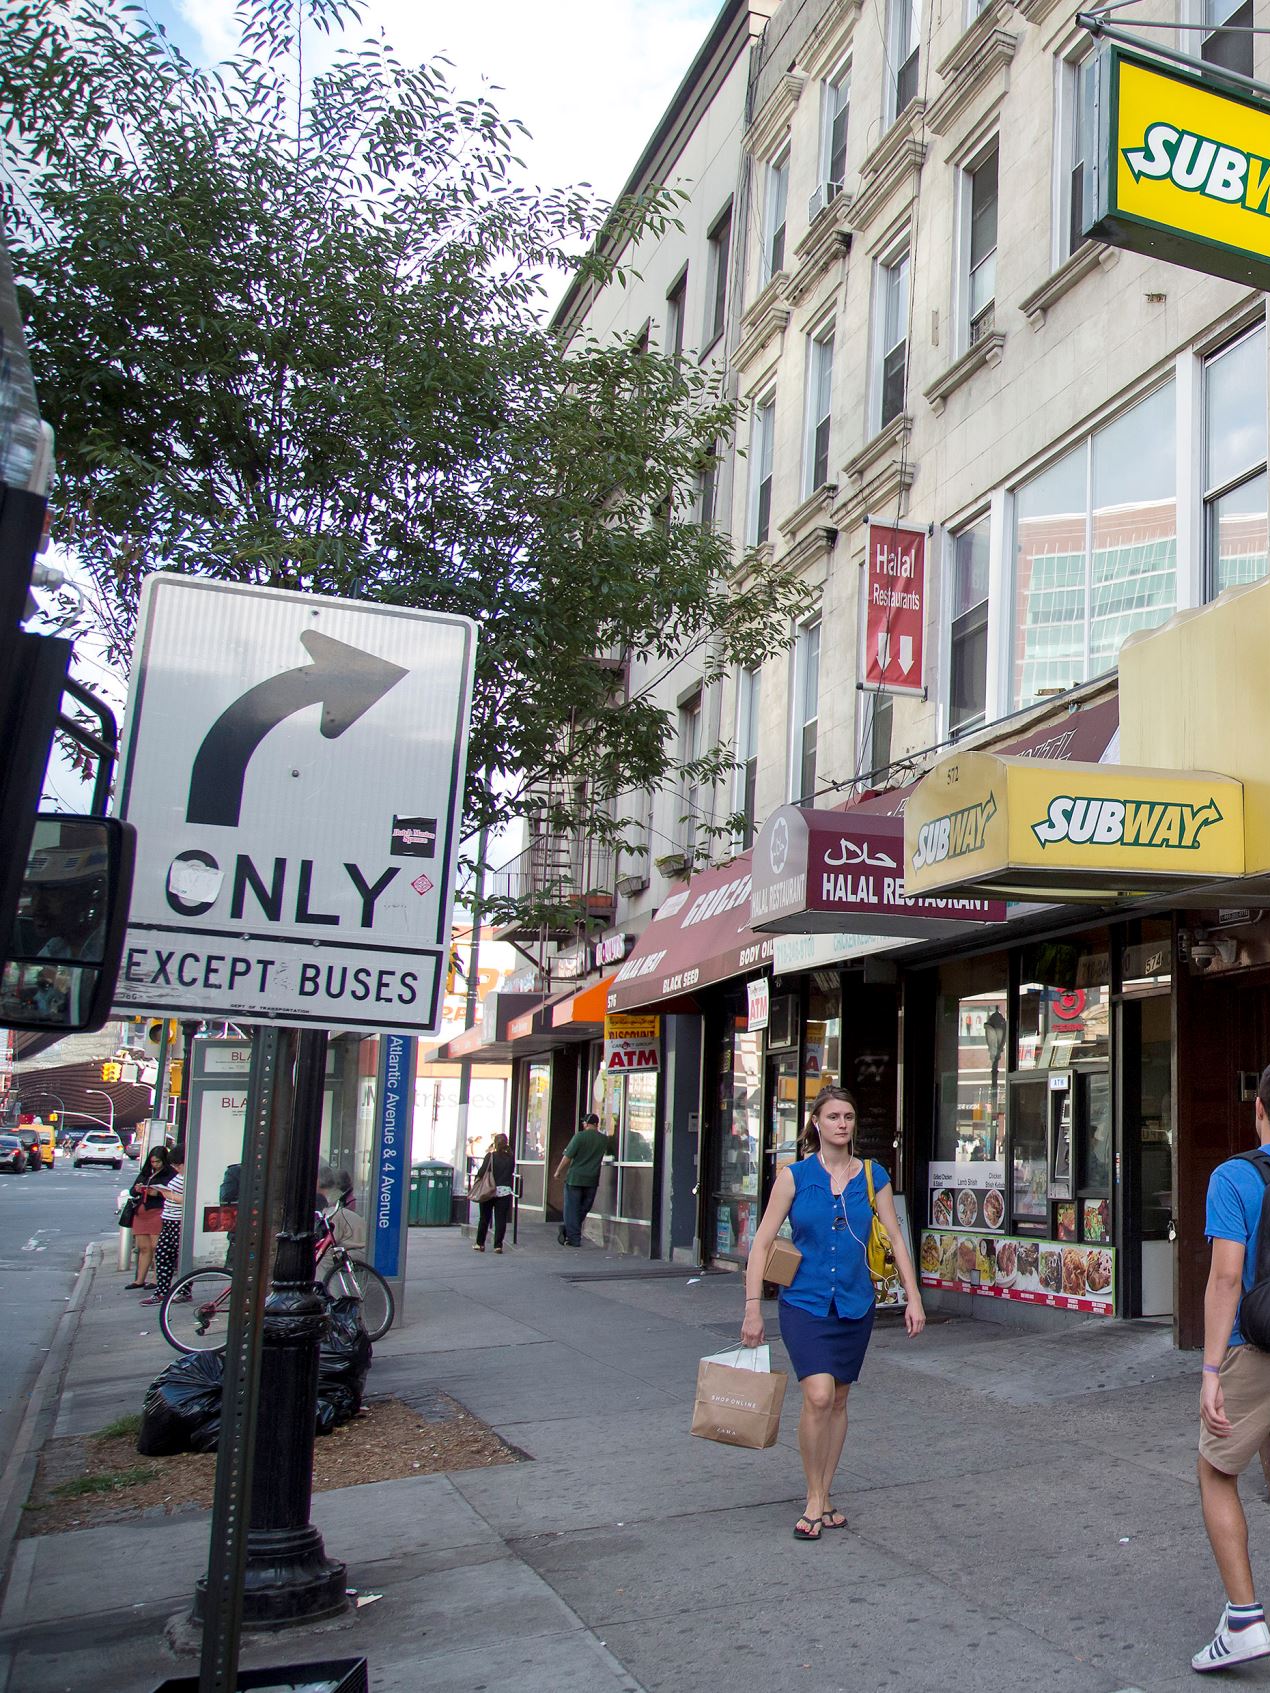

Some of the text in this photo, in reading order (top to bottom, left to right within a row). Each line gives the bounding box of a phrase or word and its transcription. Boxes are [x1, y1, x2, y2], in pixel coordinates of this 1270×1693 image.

[876, 544, 916, 578] Halal
[873, 583, 920, 611] Restaurants
[947, 766, 959, 786] 572
[912, 791, 997, 872] SUBWAY
[1031, 795, 1224, 850] SUBWAY
[824, 838, 897, 868] حلال
[166, 849, 401, 928] ONLY
[752, 874, 805, 918] HALAL RESTAURANT
[822, 873, 878, 903] HALAL
[739, 945, 760, 967] BODY
[1145, 952, 1162, 974] 574
[124, 948, 418, 1005] EXCEPT BUSES
[663, 968, 699, 993] BLACK SEED
[259, 1006, 310, 1014] TRANSPORTATION
[608, 994, 617, 1009] 576
[750, 995, 768, 1021] ATM
[608, 1050, 658, 1069] ATM
[379, 1036, 403, 1229] Atlantic Avenue & 4 Avenue
[711, 1394, 730, 1403] SHOP
[730, 1399, 757, 1409] ONLINE
[716, 1427, 736, 1435] ZARA
